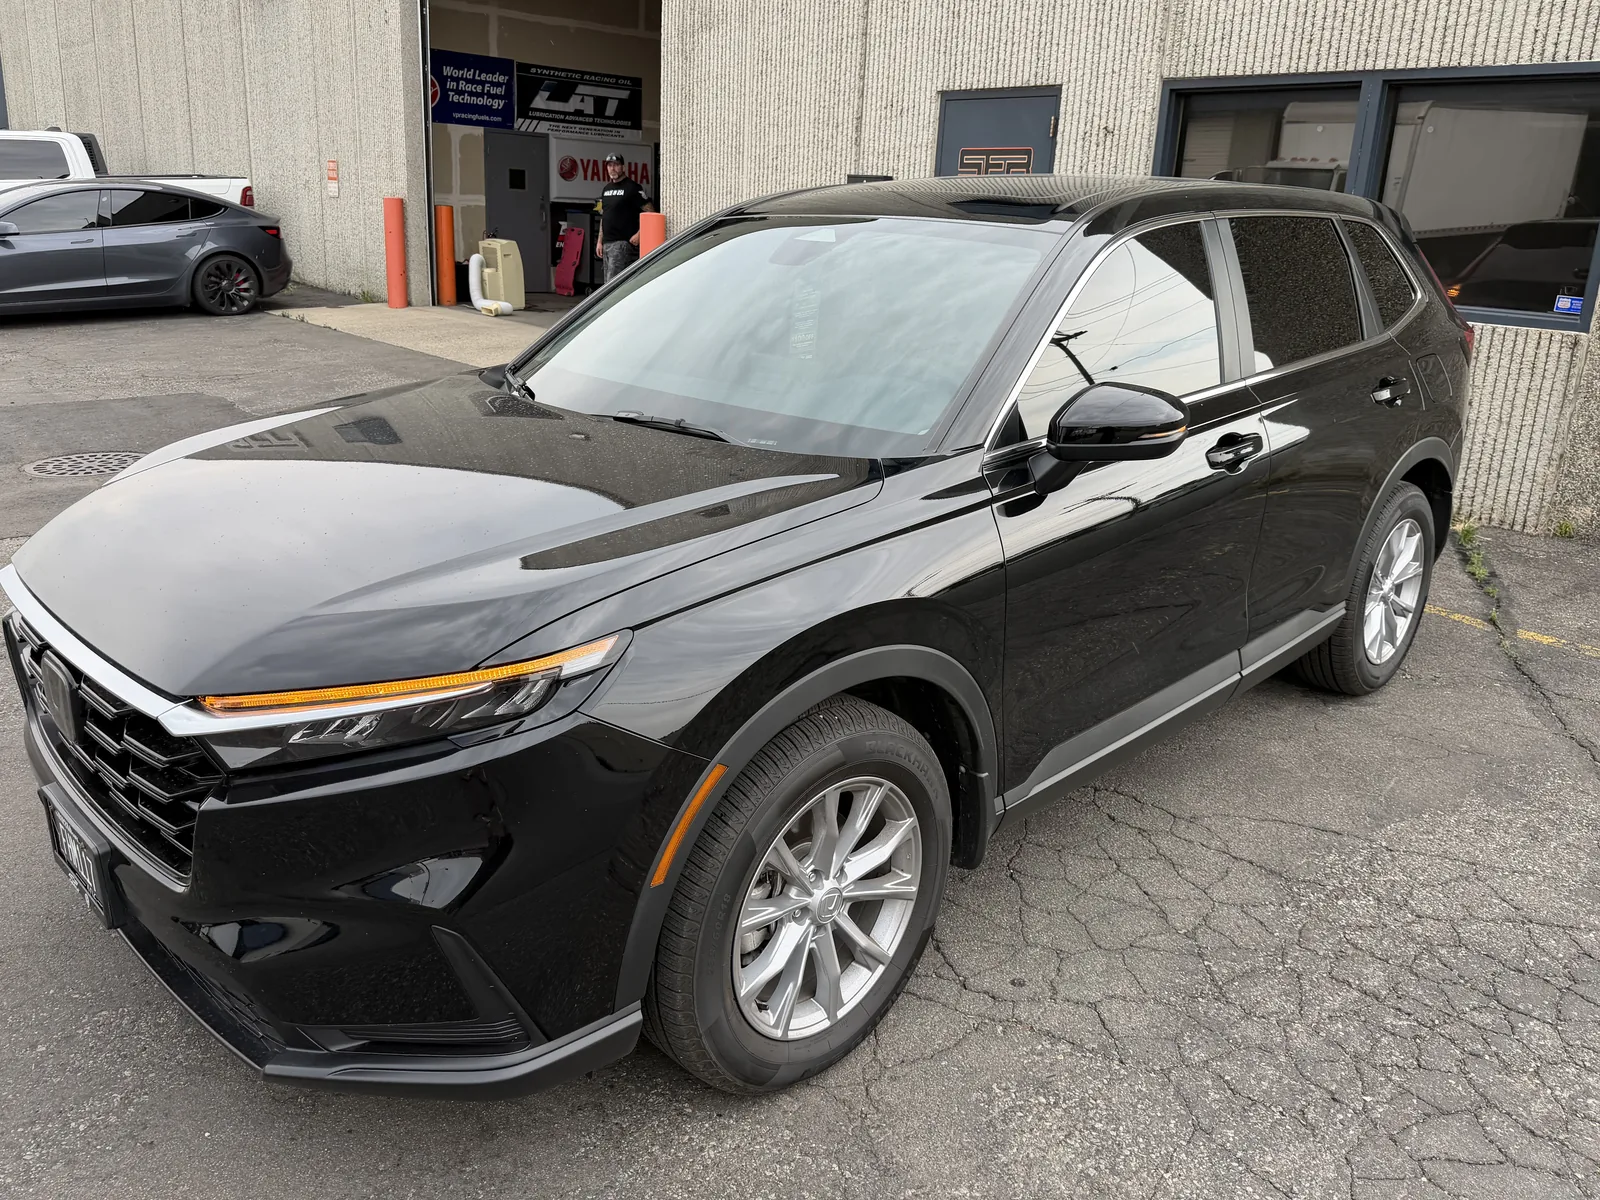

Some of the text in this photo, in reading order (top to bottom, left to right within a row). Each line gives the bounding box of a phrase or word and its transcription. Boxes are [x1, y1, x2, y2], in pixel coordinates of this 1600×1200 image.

[443, 65, 509, 84] World Leader
[530, 67, 582, 80] SYNTHETIC
[583, 74, 617, 84] RACING
[446, 78, 505, 96] in Race Fuel
[448, 91, 505, 110] Technology
[530, 80, 631, 117] LAT
[452, 112, 503, 122] vpracingfuels.com
[528, 110, 632, 127] LUBRICATION ADVANCED TECHNOLOGIES
[547, 128, 625, 139] PERFORMANCE LUBRICANTS
[581, 126, 613, 134] GENERATION
[579, 158, 651, 185] YAMHA
[864, 740, 939, 801] BLACKHA
